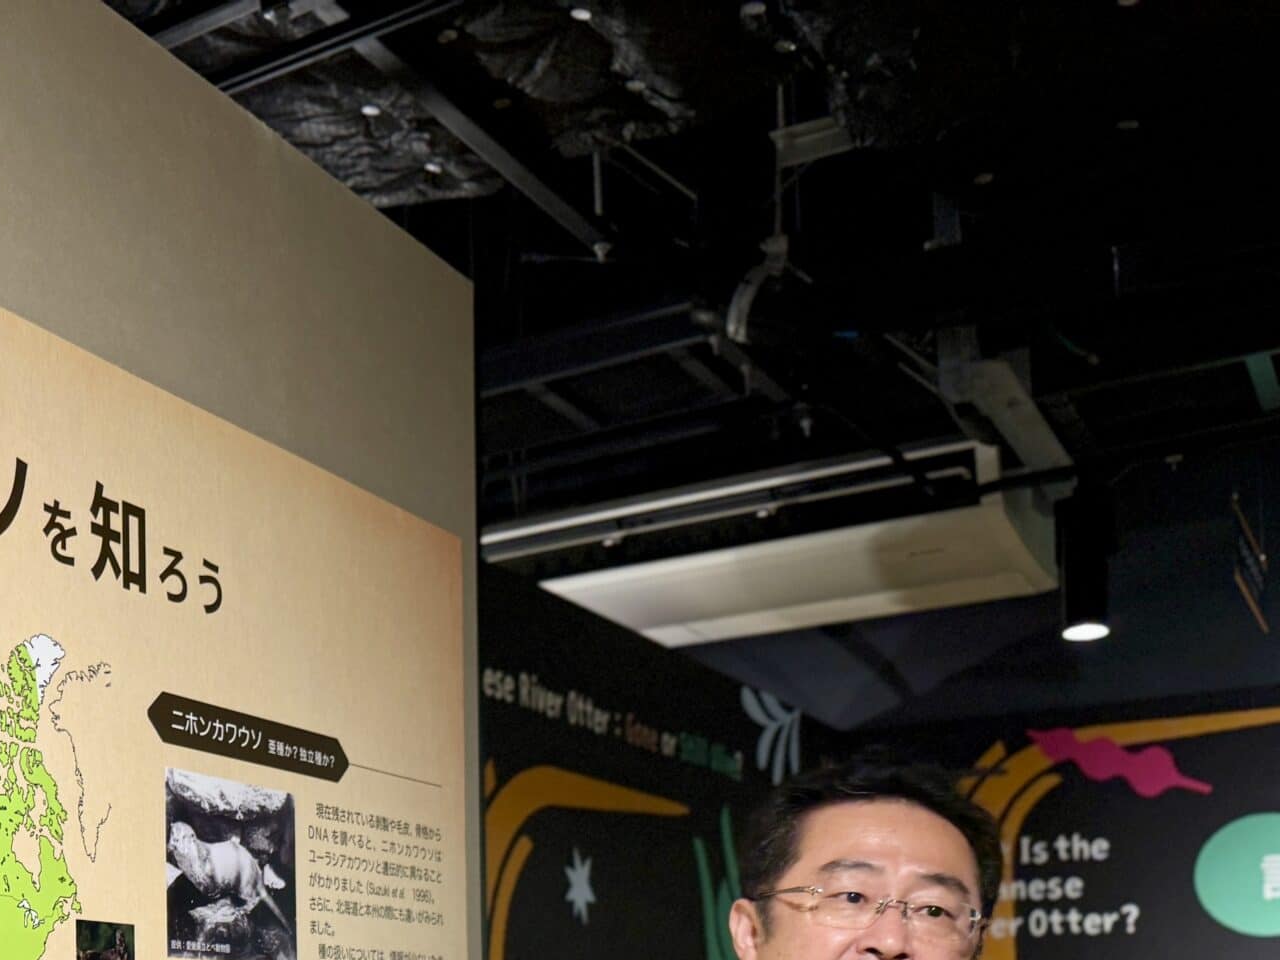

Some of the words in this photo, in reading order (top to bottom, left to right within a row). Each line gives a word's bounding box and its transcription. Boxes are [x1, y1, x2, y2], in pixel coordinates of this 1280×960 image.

[519, 671, 564, 719] River
[567, 690, 611, 735] Otter
[171, 710, 262, 750] ニホンカワウソ
[1020, 836, 1050, 865] Is
[1054, 832, 1111, 862] the
